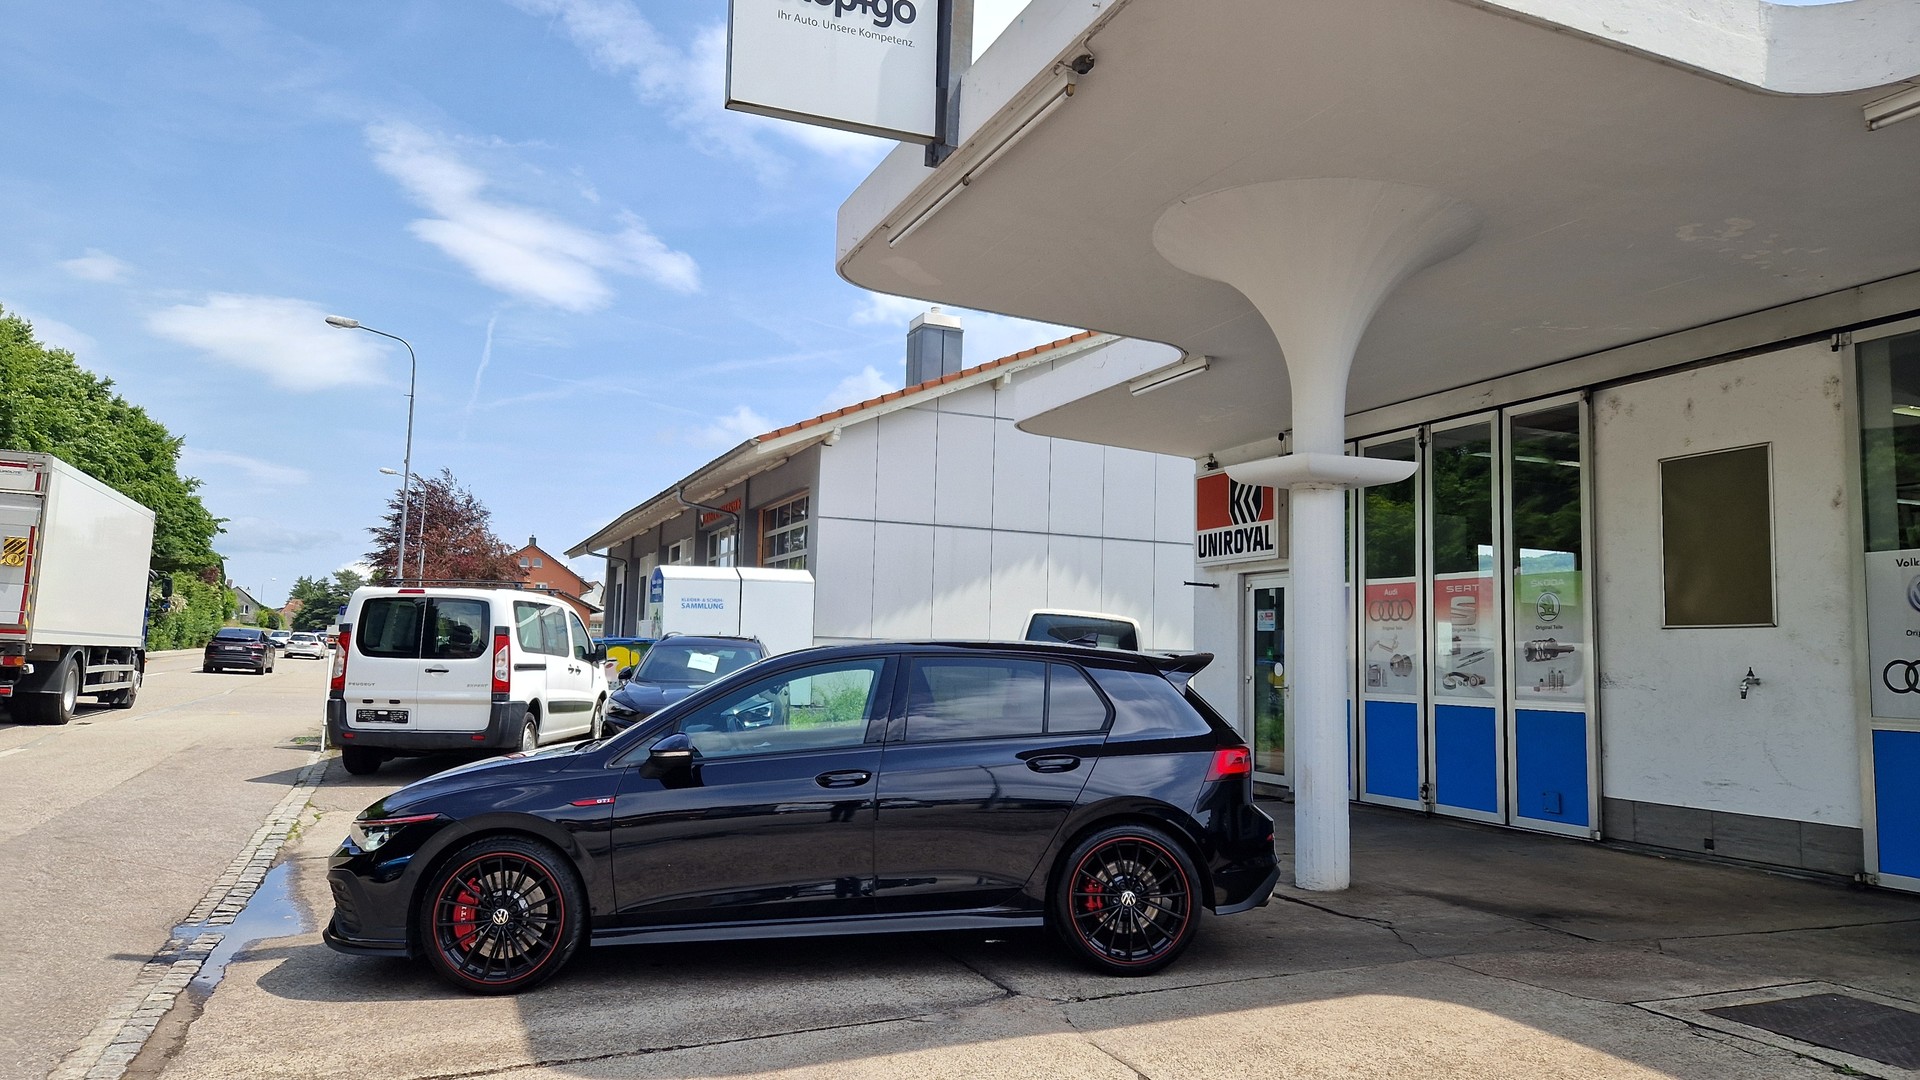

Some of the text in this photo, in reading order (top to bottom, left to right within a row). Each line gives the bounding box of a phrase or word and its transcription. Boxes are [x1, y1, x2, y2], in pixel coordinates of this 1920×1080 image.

[777, 9, 916, 48] Ihr Auto. Unsere Kompetenz.
[1197, 524, 1274, 559] UNIROYAL
[1384, 588, 1398, 596] Audi
[1445, 584, 1479, 593] SEAT
[681, 602, 724, 610] SAMMLUNG
